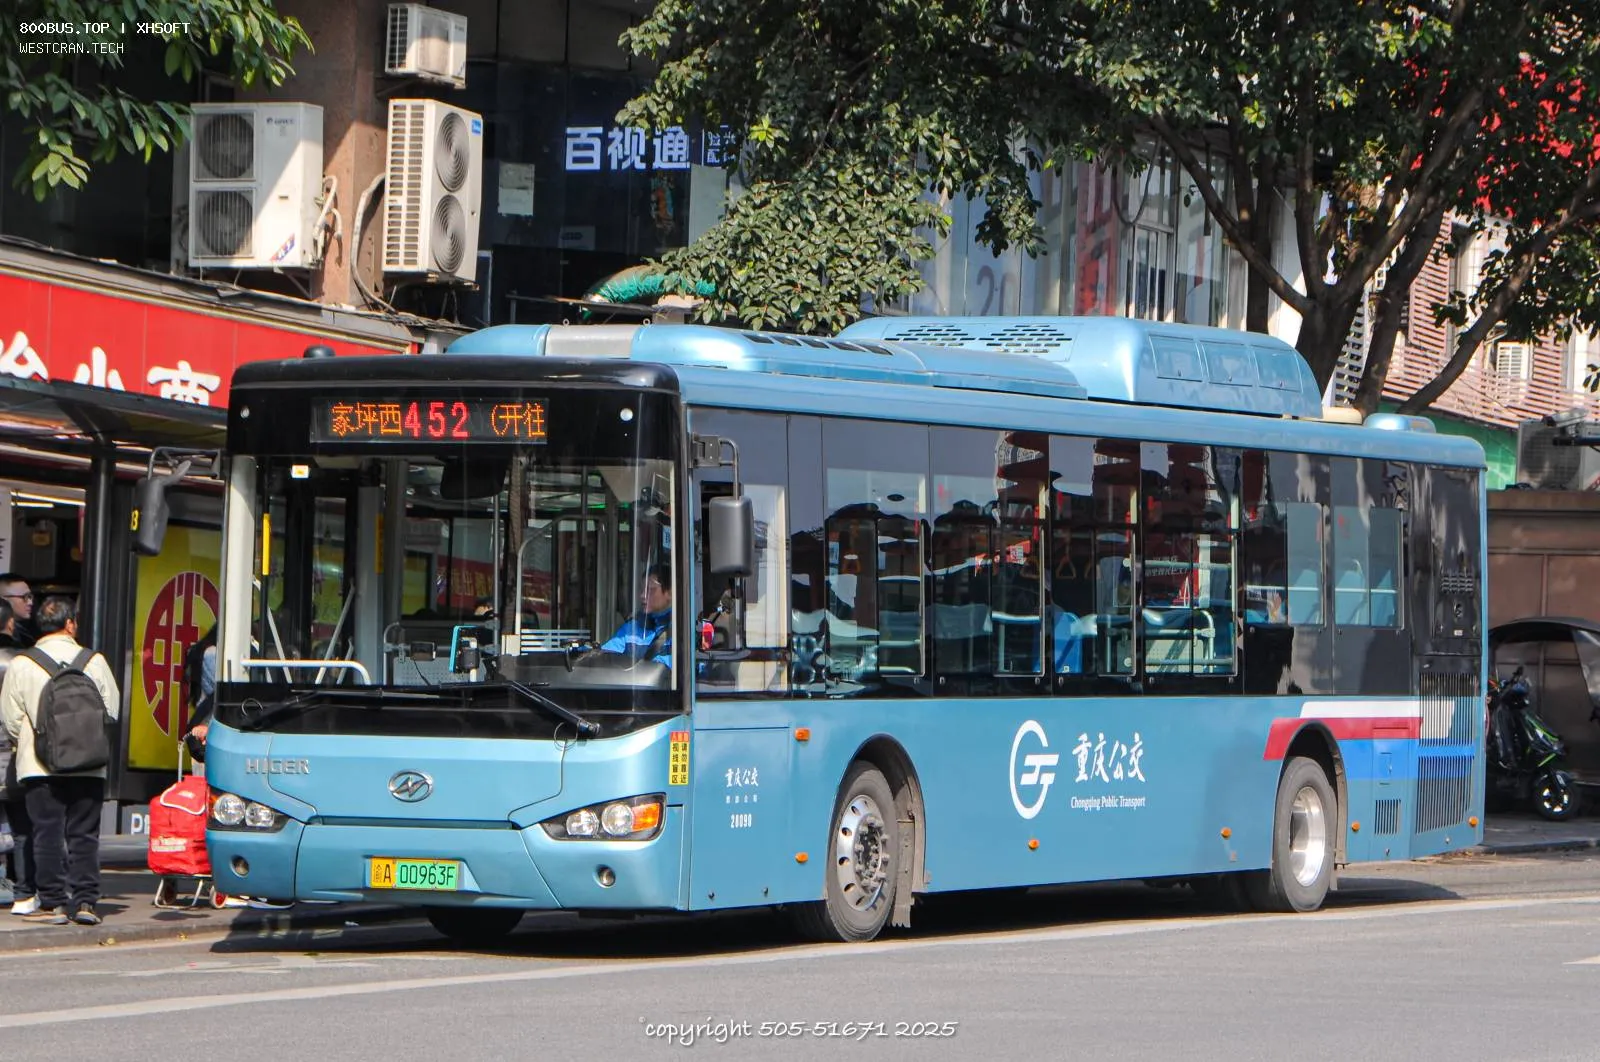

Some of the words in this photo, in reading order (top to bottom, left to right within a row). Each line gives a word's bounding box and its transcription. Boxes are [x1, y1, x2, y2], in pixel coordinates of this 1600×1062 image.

[565, 125, 691, 171] 百视通
[404, 402, 469, 437] 452
[245, 757, 310, 775] HIGER
[1072, 731, 1146, 783] 重庆公交
[725, 767, 759, 788] 重庆公交
[1070, 795, 1100, 811] Chongqing
[1101, 794, 1119, 808] Public
[1119, 794, 1146, 810] Transport
[400, 864, 455, 886] 00963F
